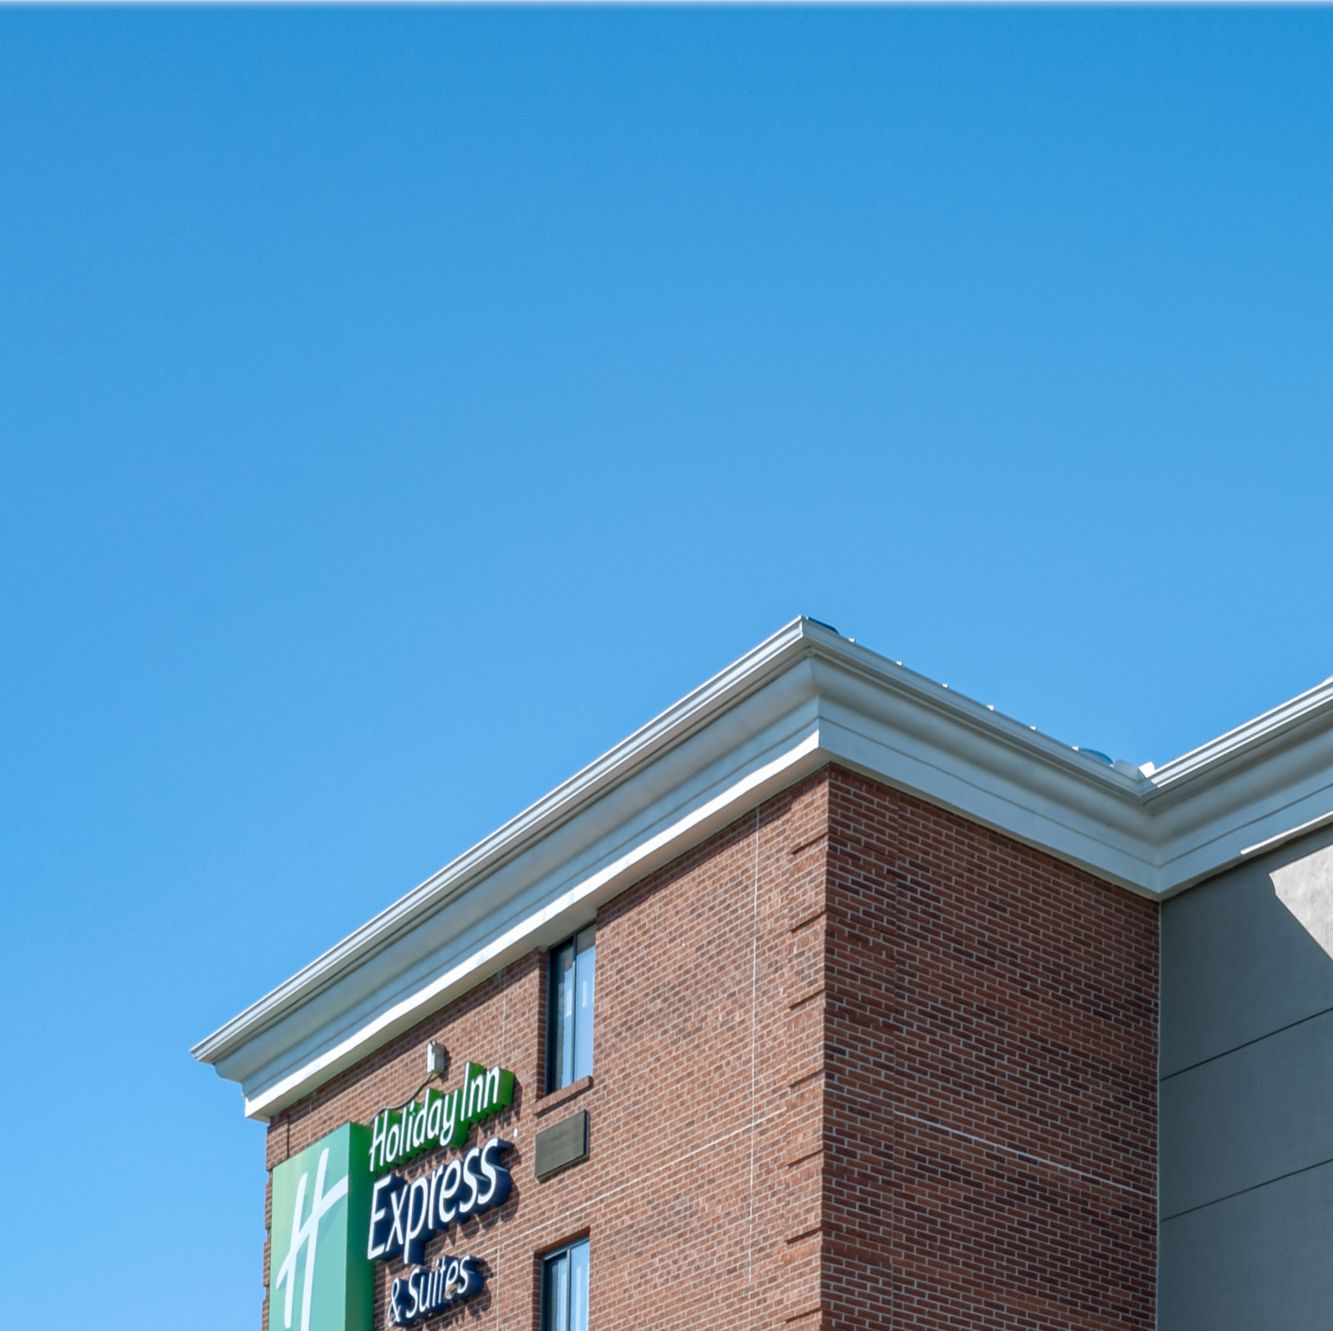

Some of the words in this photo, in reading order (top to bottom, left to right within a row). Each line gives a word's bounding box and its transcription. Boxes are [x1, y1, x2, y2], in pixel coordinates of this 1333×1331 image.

[368, 1086, 458, 1173] Holiday
[460, 1060, 501, 1123] Inn
[367, 1137, 499, 1265] Express
[387, 1277, 401, 1328] &
[405, 1254, 471, 1319] Suites
